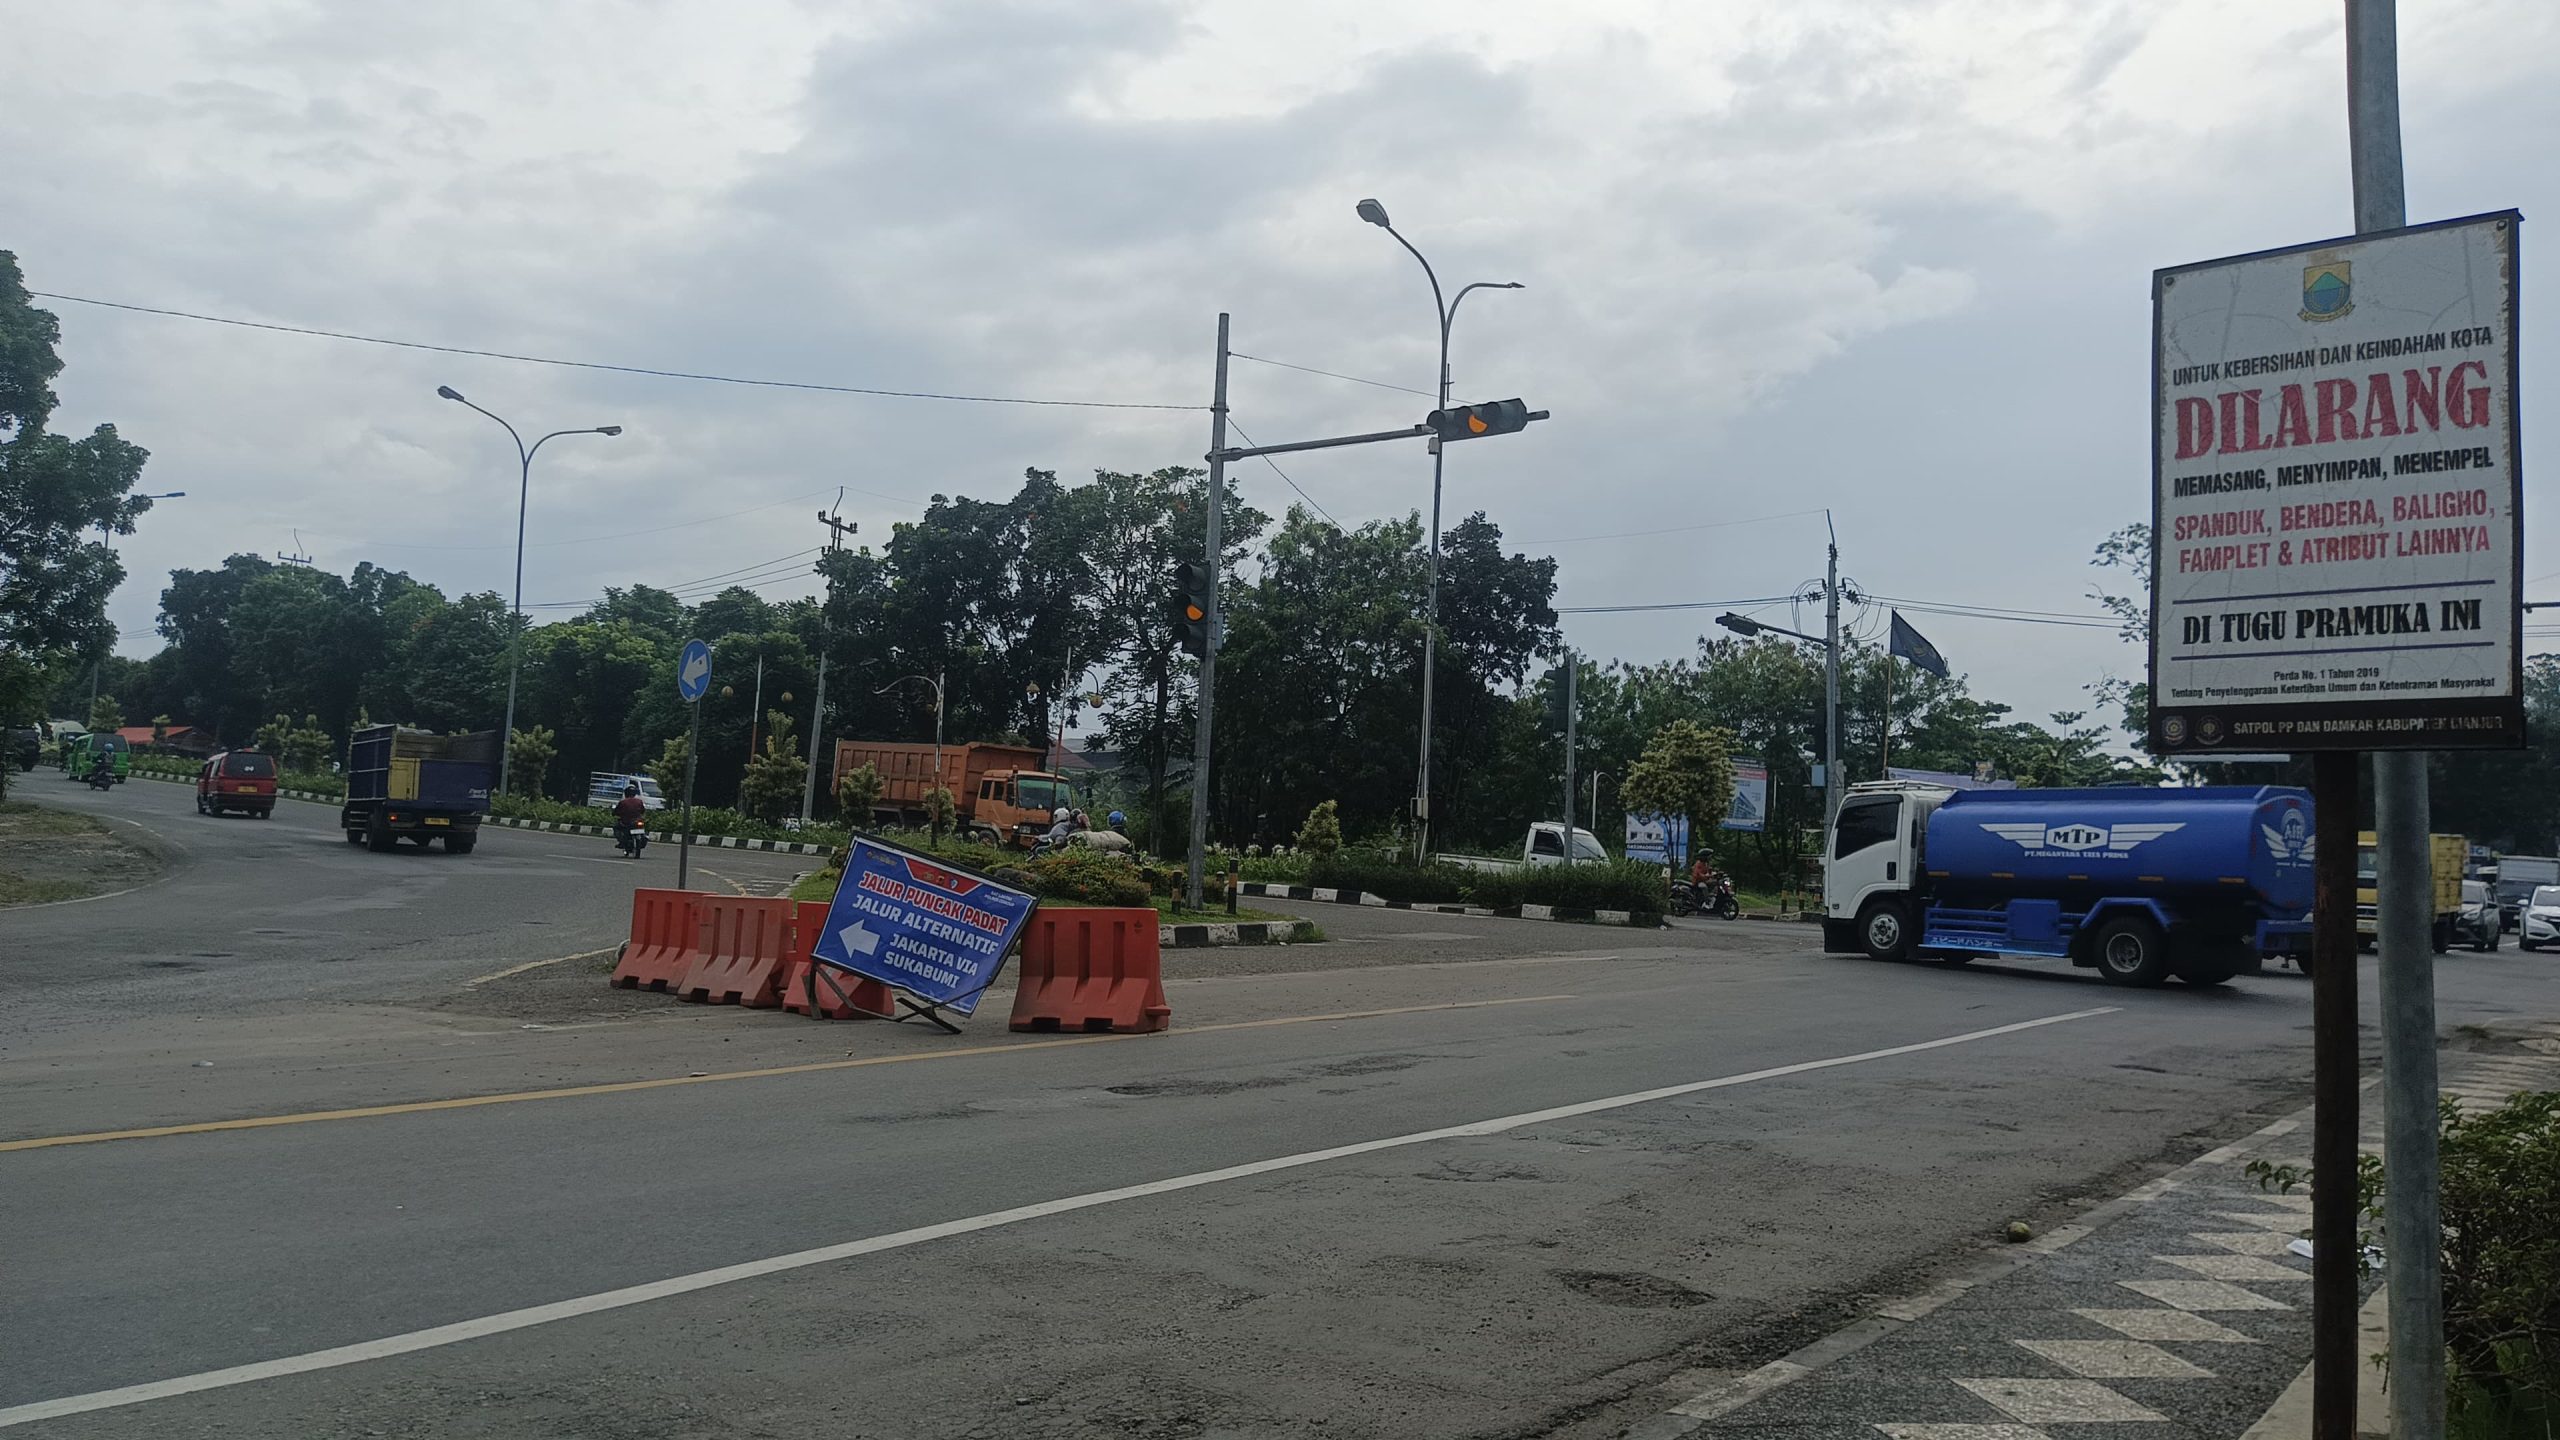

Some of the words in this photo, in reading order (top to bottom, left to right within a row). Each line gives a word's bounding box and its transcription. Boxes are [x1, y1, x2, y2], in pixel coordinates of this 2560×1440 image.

[2173, 363, 2220, 387] UNTUK
[2223, 349, 2315, 379] KEBERSIHAN
[2320, 345, 2352, 367] DAN
[2356, 332, 2446, 361] KEINDAHAN
[2450, 326, 2493, 349] KOTA
[2174, 360, 2492, 461] DILARANG
[2174, 467, 2272, 498] MEMASANG,
[2277, 456, 2388, 487] MENYIMPAN,
[2393, 446, 2494, 475] MENEMPEL
[2174, 508, 2273, 542] SPANDUK,
[2280, 498, 2385, 532] BENDERA,
[2392, 488, 2496, 522] BALIGHO,
[2179, 542, 2271, 574] FAMPLET
[2278, 540, 2293, 566] &
[2301, 532, 2390, 565] ATRIBUT
[2396, 525, 2490, 558] LAINNYA
[2182, 615, 2212, 645] DI
[2220, 610, 2287, 643] TUGU
[2295, 602, 2431, 639] PRAMUKA
[2440, 599, 2482, 632] INI
[2171, 688, 2204, 699] Tentang
[2280, 683, 2327, 695] Ketertiban
[2328, 682, 2358, 693] Umum
[2359, 681, 2378, 692] dan
[2379, 679, 2438, 692] Ketentraman
[2440, 677, 2495, 691] Masyarakat
[2273, 670, 2298, 681] Perda
[2301, 669, 2318, 681] No.
[2328, 668, 2355, 680] Tahun
[2357, 667, 2380, 679] 2019
[2234, 721, 2276, 735] SATPOL
[2278, 721, 2293, 734] PP
[2297, 720, 2321, 733] DAN
[2323, 719, 2374, 733] DAMKAR
[2053, 828, 2100, 844] MTP
[852, 893, 902, 923] JALUR
[903, 911, 999, 956] ALTERNATIF
[858, 871, 905, 899] JALUR
[903, 886, 964, 918] PUNCAK
[962, 906, 1009, 936] PADAT
[884, 952, 961, 989] SUKABUMI
[890, 933, 954, 968] JAKARTA
[956, 956, 979, 977] VIA
